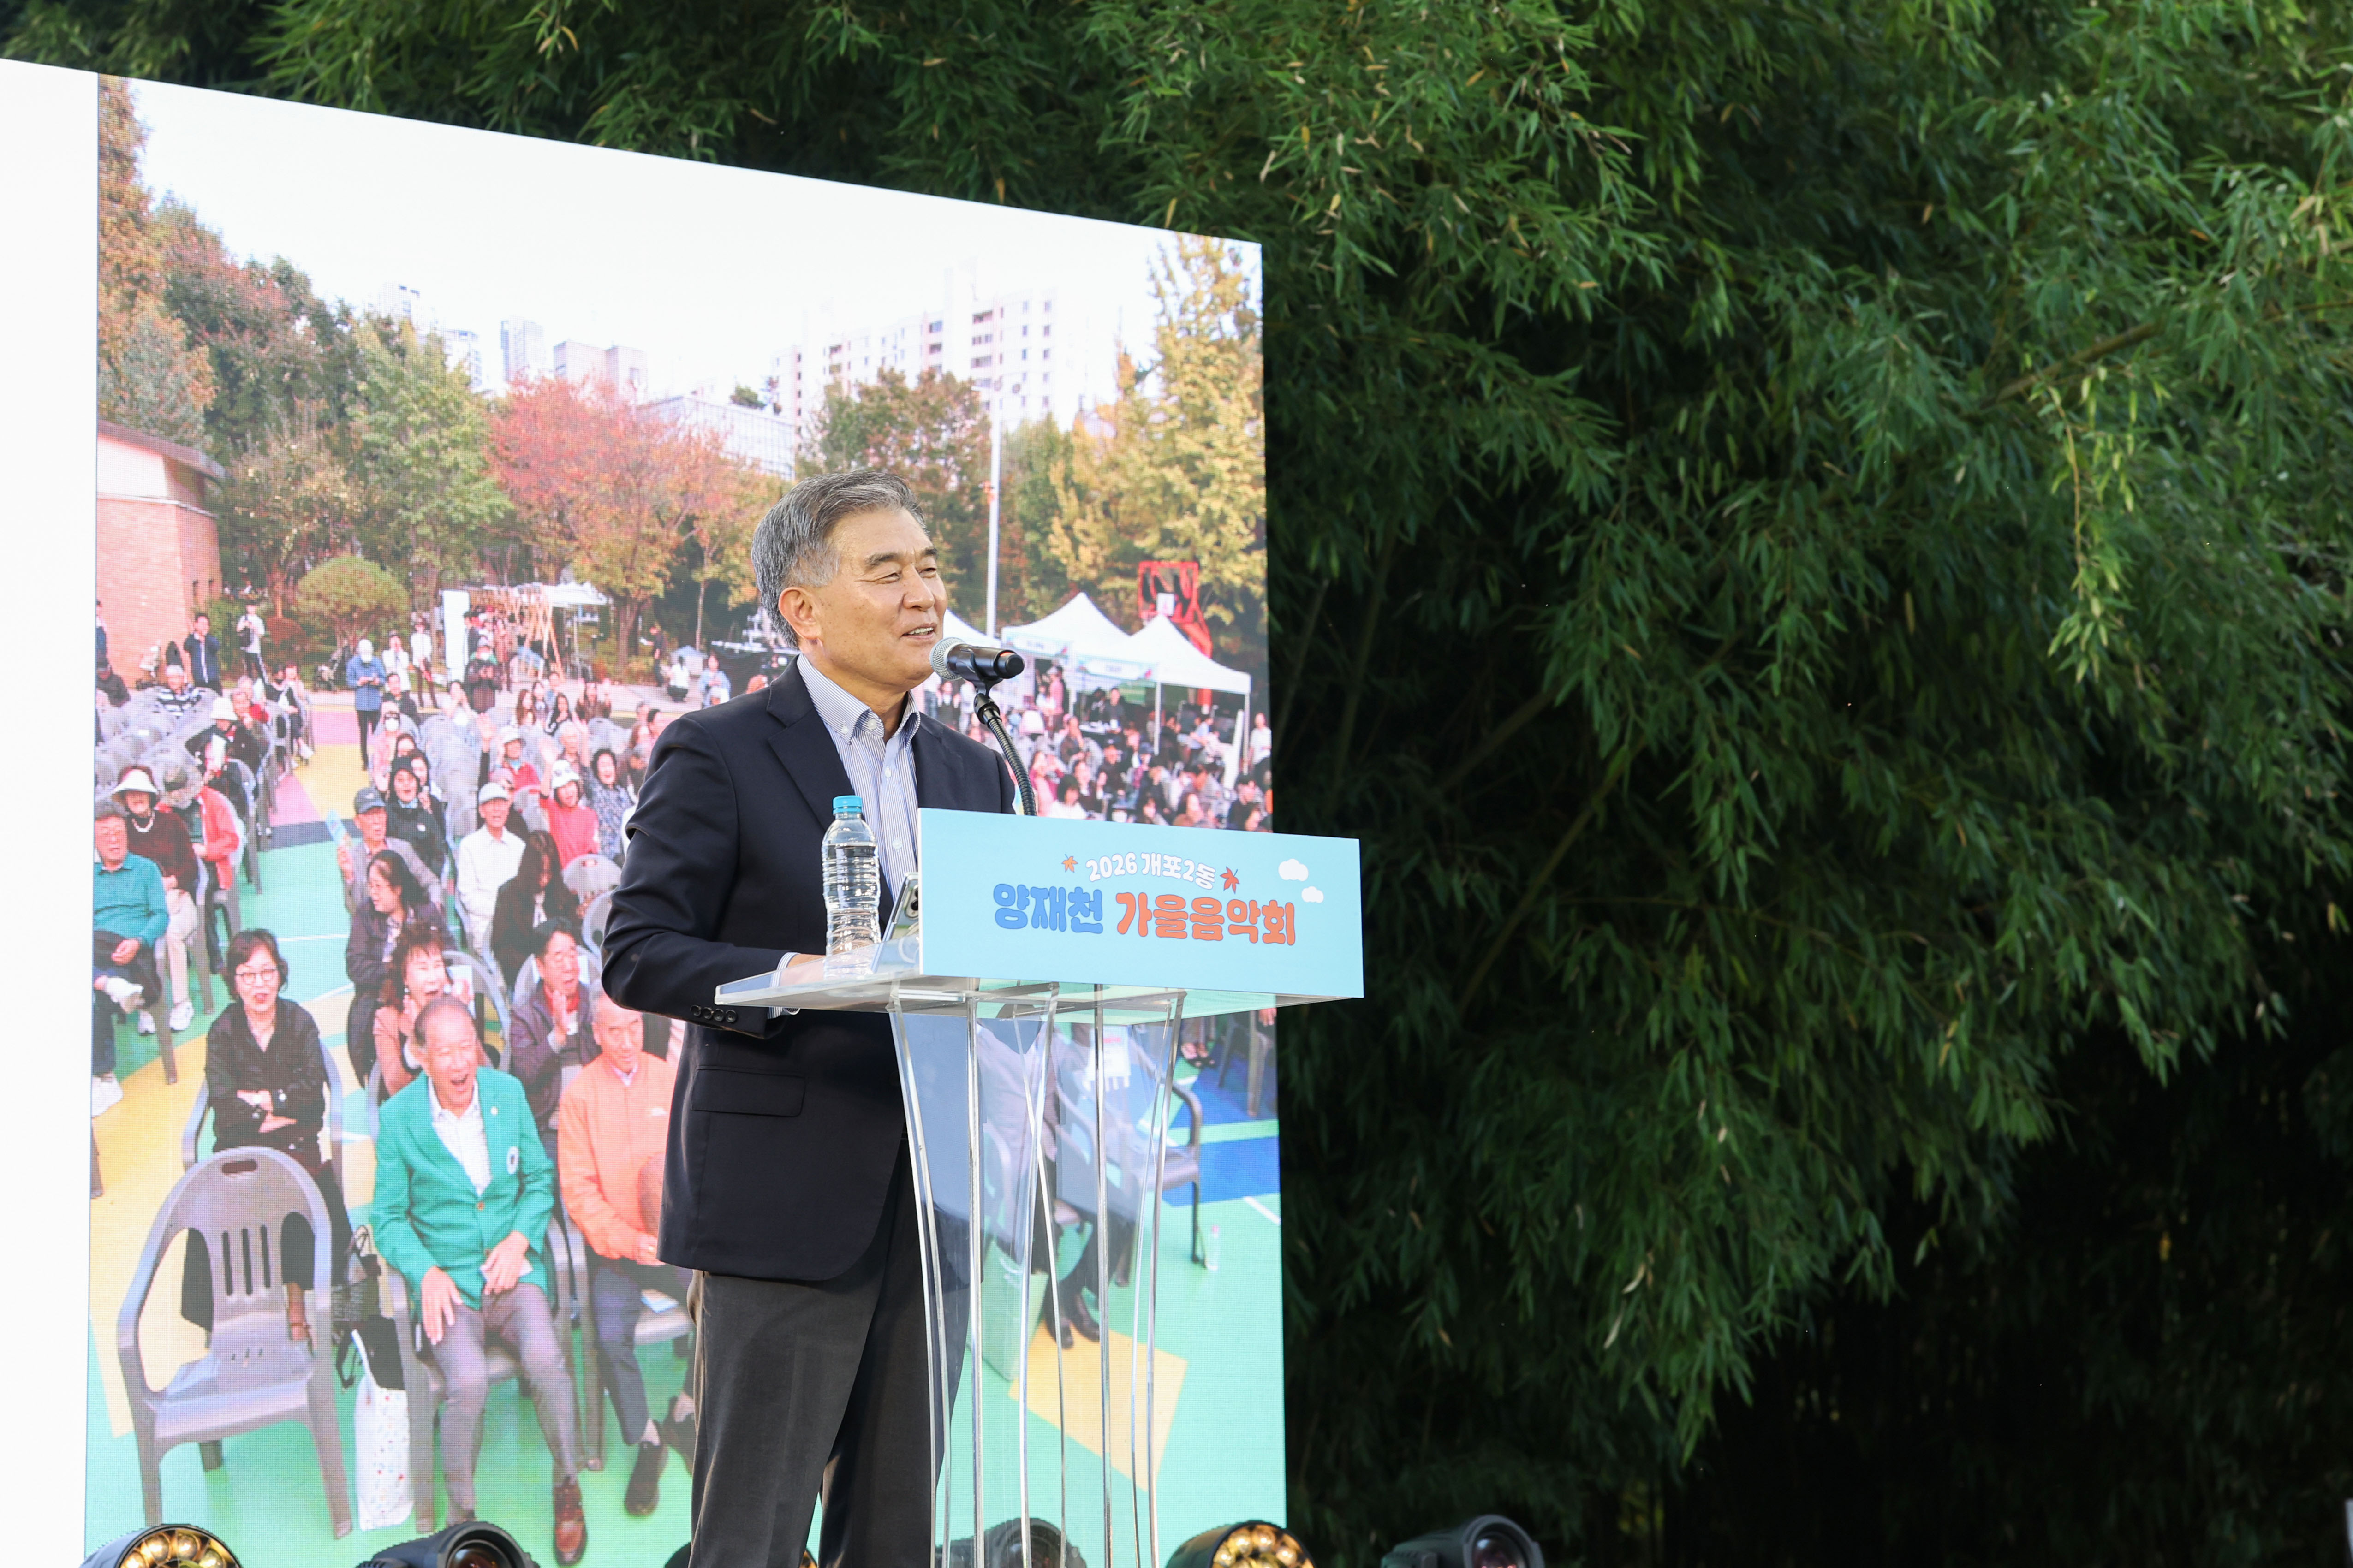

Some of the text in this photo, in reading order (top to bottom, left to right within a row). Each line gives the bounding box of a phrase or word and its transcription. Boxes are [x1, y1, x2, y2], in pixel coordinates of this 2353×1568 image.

[1085, 852, 1216, 890] 2026 개포2동
[993, 883, 1295, 946] 양재천 가을음악회
